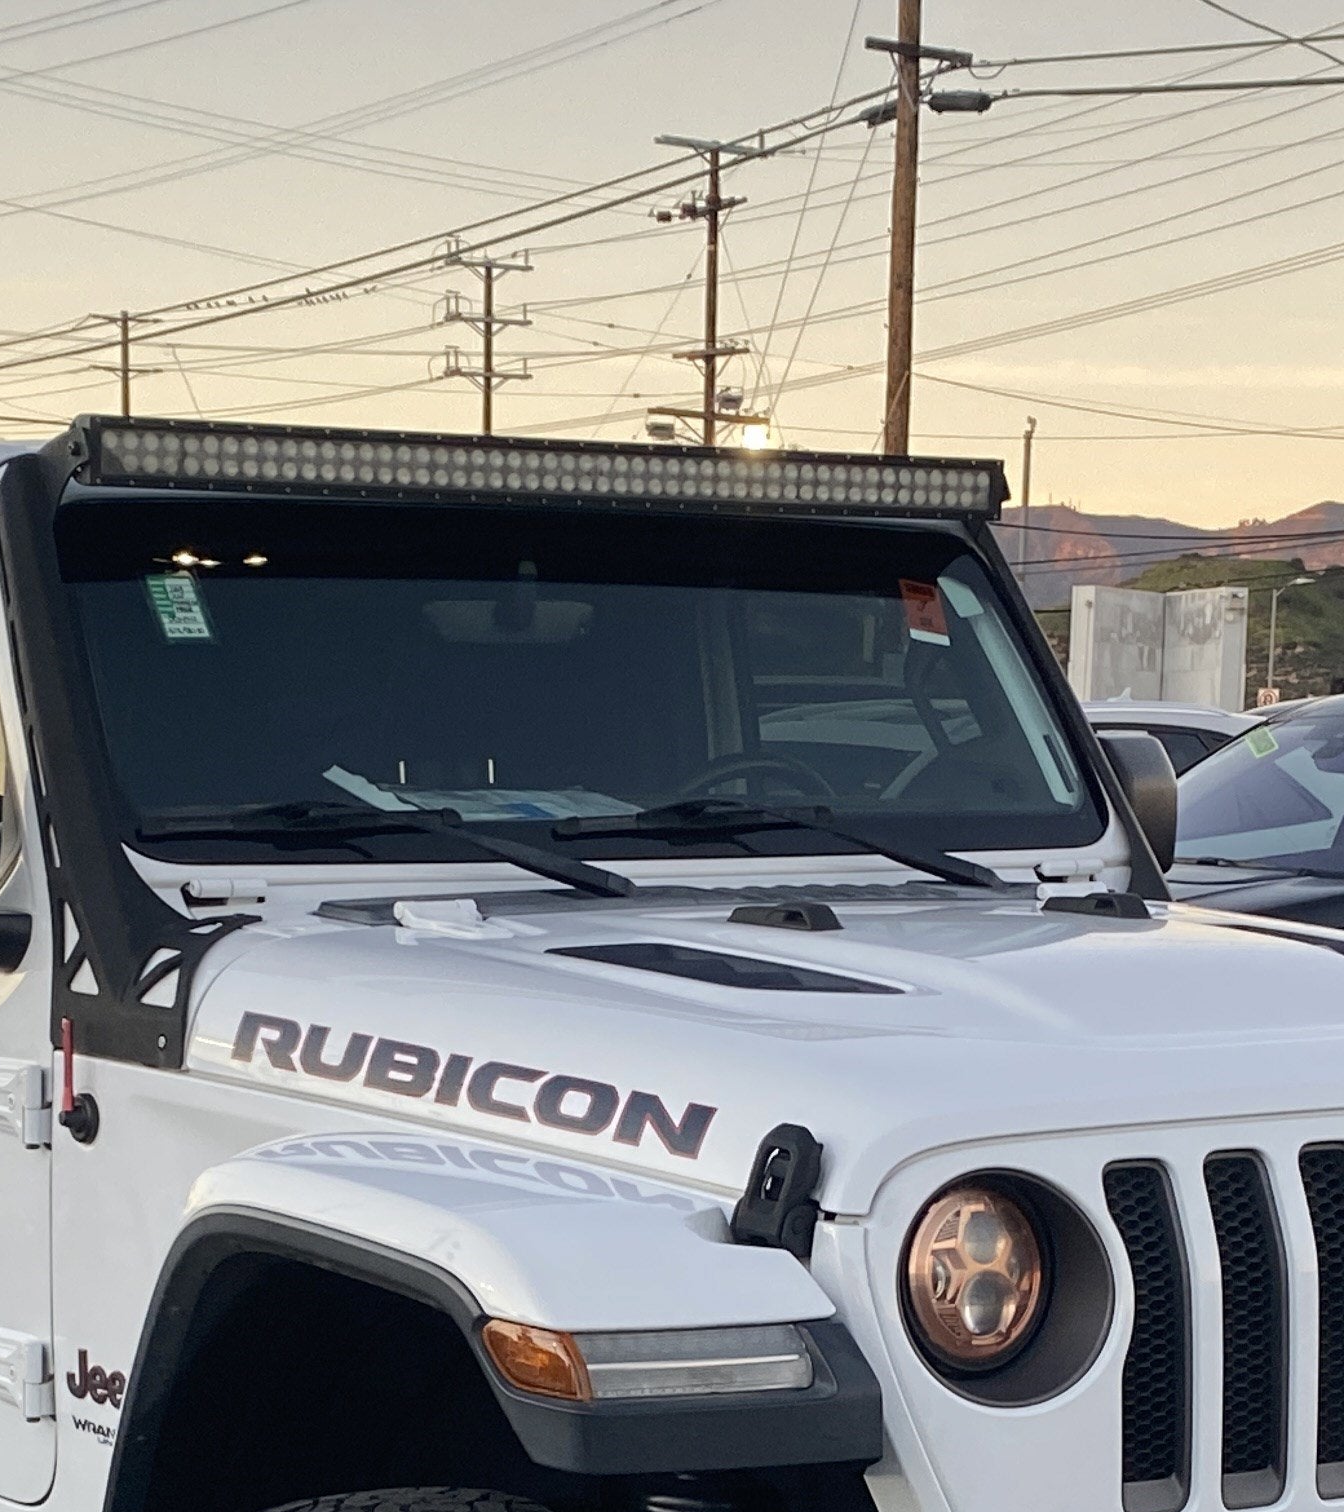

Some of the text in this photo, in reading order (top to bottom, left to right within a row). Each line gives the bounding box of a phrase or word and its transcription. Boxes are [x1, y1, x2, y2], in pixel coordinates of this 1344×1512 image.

[230, 1010, 718, 1160] RUBICON
[66, 1348, 126, 1410] Jee
[71, 1414, 117, 1440] WRAN
